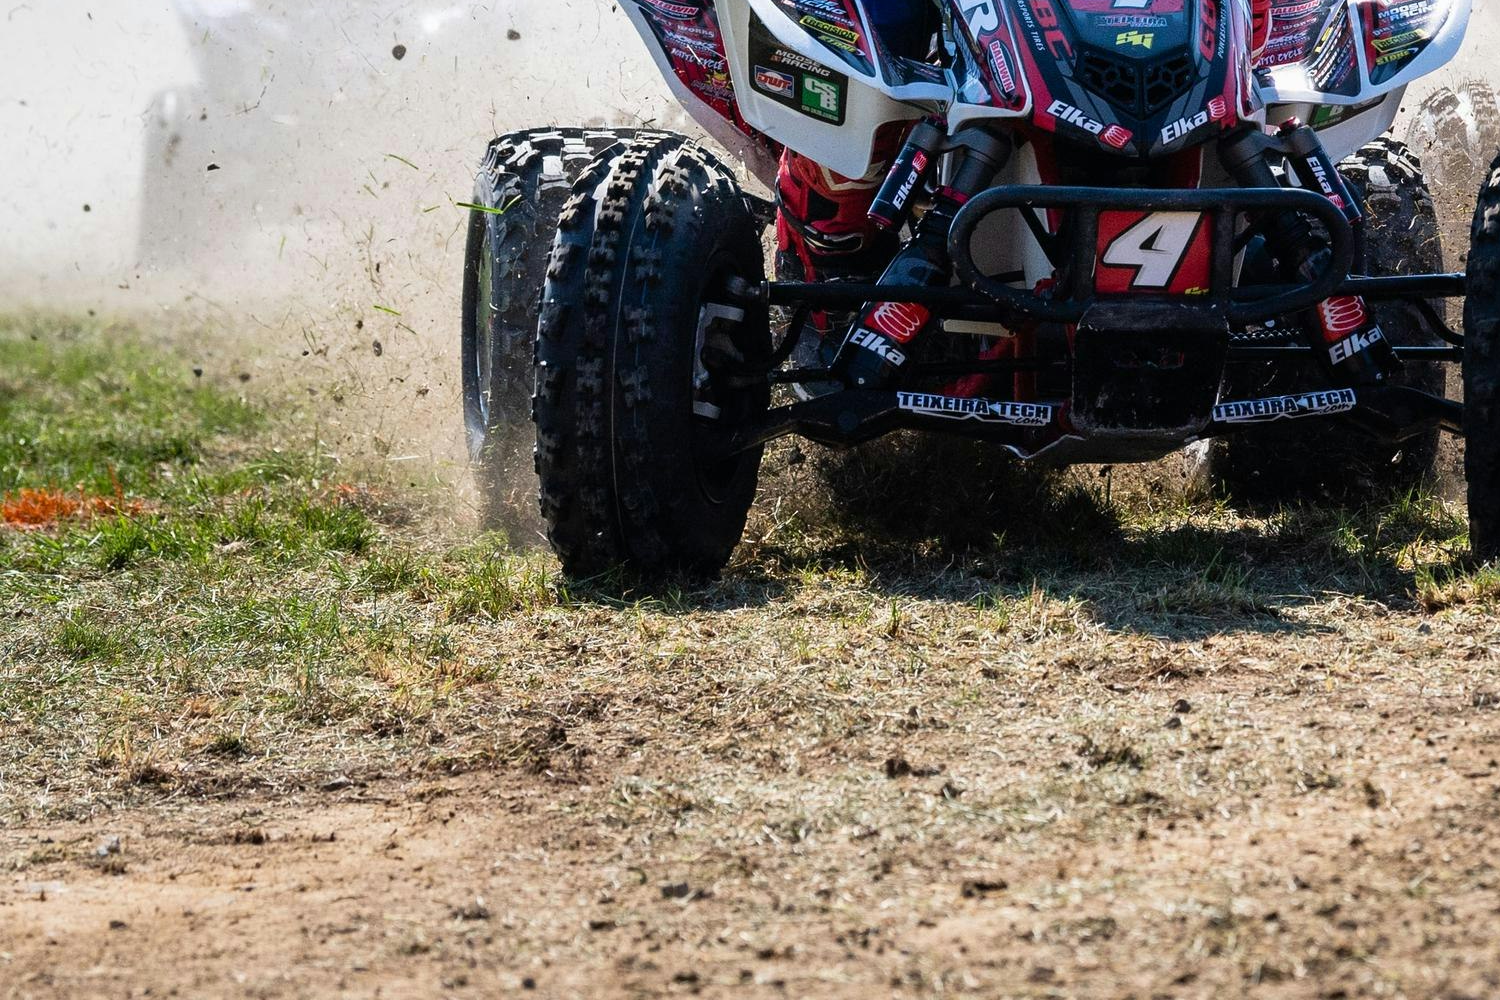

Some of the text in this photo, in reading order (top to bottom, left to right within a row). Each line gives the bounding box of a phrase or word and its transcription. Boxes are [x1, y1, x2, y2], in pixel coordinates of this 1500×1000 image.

[781, 58, 831, 77] RACING
[989, 39, 1014, 93] BALDWIN
[1046, 100, 1105, 135] Elka
[1161, 110, 1209, 145] Elka
[893, 170, 919, 212] Elka
[1306, 154, 1333, 197] Elka
[1104, 211, 1202, 288] 4
[848, 327, 906, 368] Elka
[1329, 325, 1385, 366] Elka
[900, 391, 1052, 421] TEIXEIRA TECH
[1214, 388, 1356, 420] TEIXEIRA TECH
